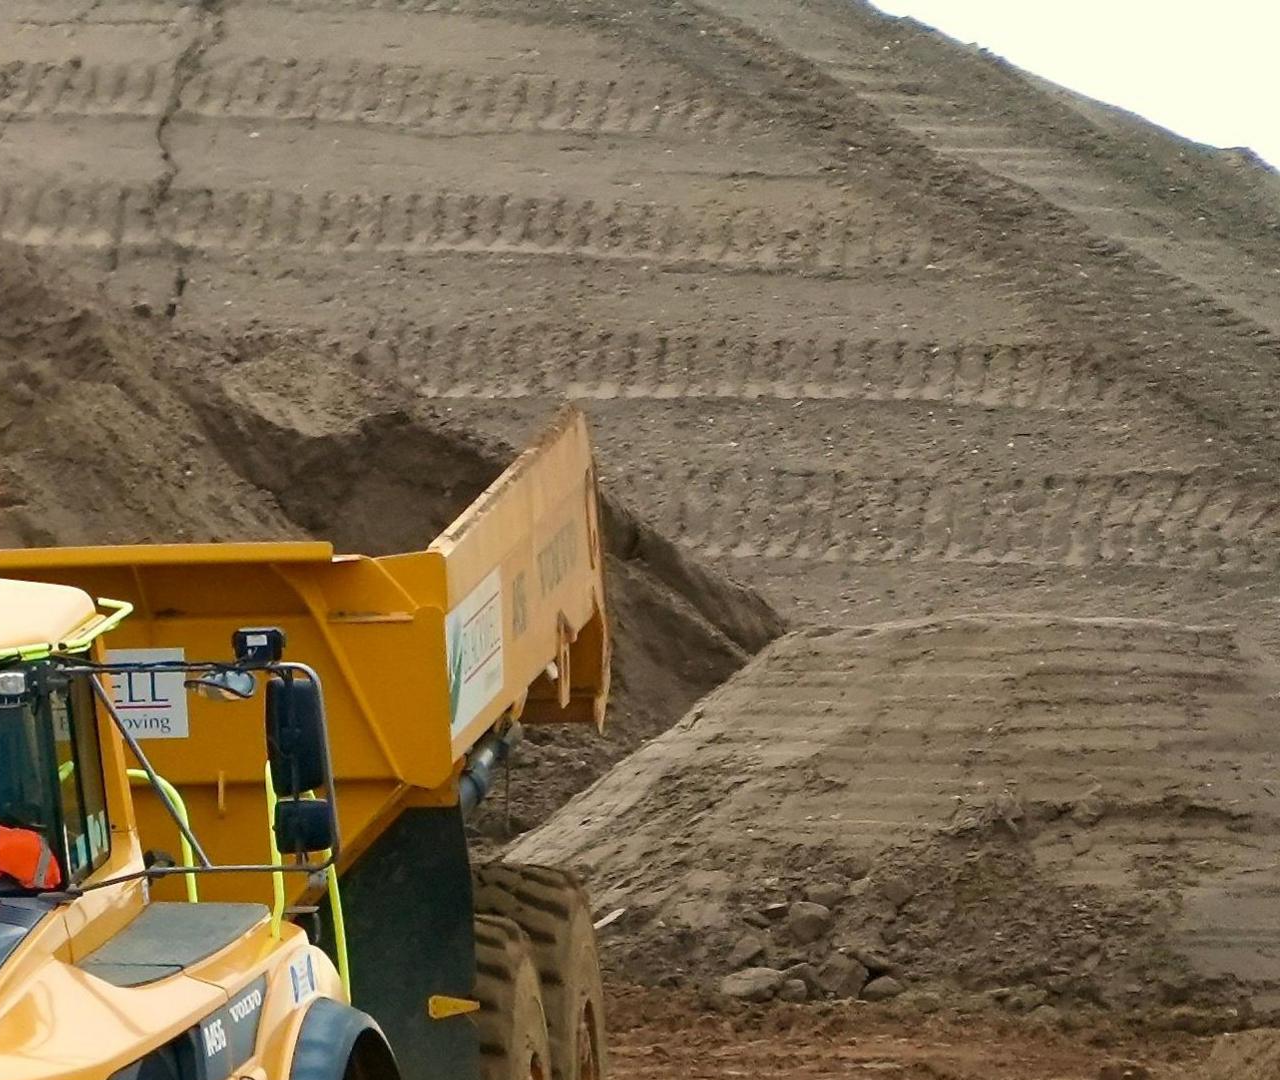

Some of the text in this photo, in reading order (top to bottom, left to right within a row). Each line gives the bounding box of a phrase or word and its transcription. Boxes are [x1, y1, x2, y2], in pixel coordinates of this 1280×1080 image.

[109, 669, 169, 703] ELL
[122, 713, 172, 734] oving
[228, 989, 262, 1023] VOLVO
